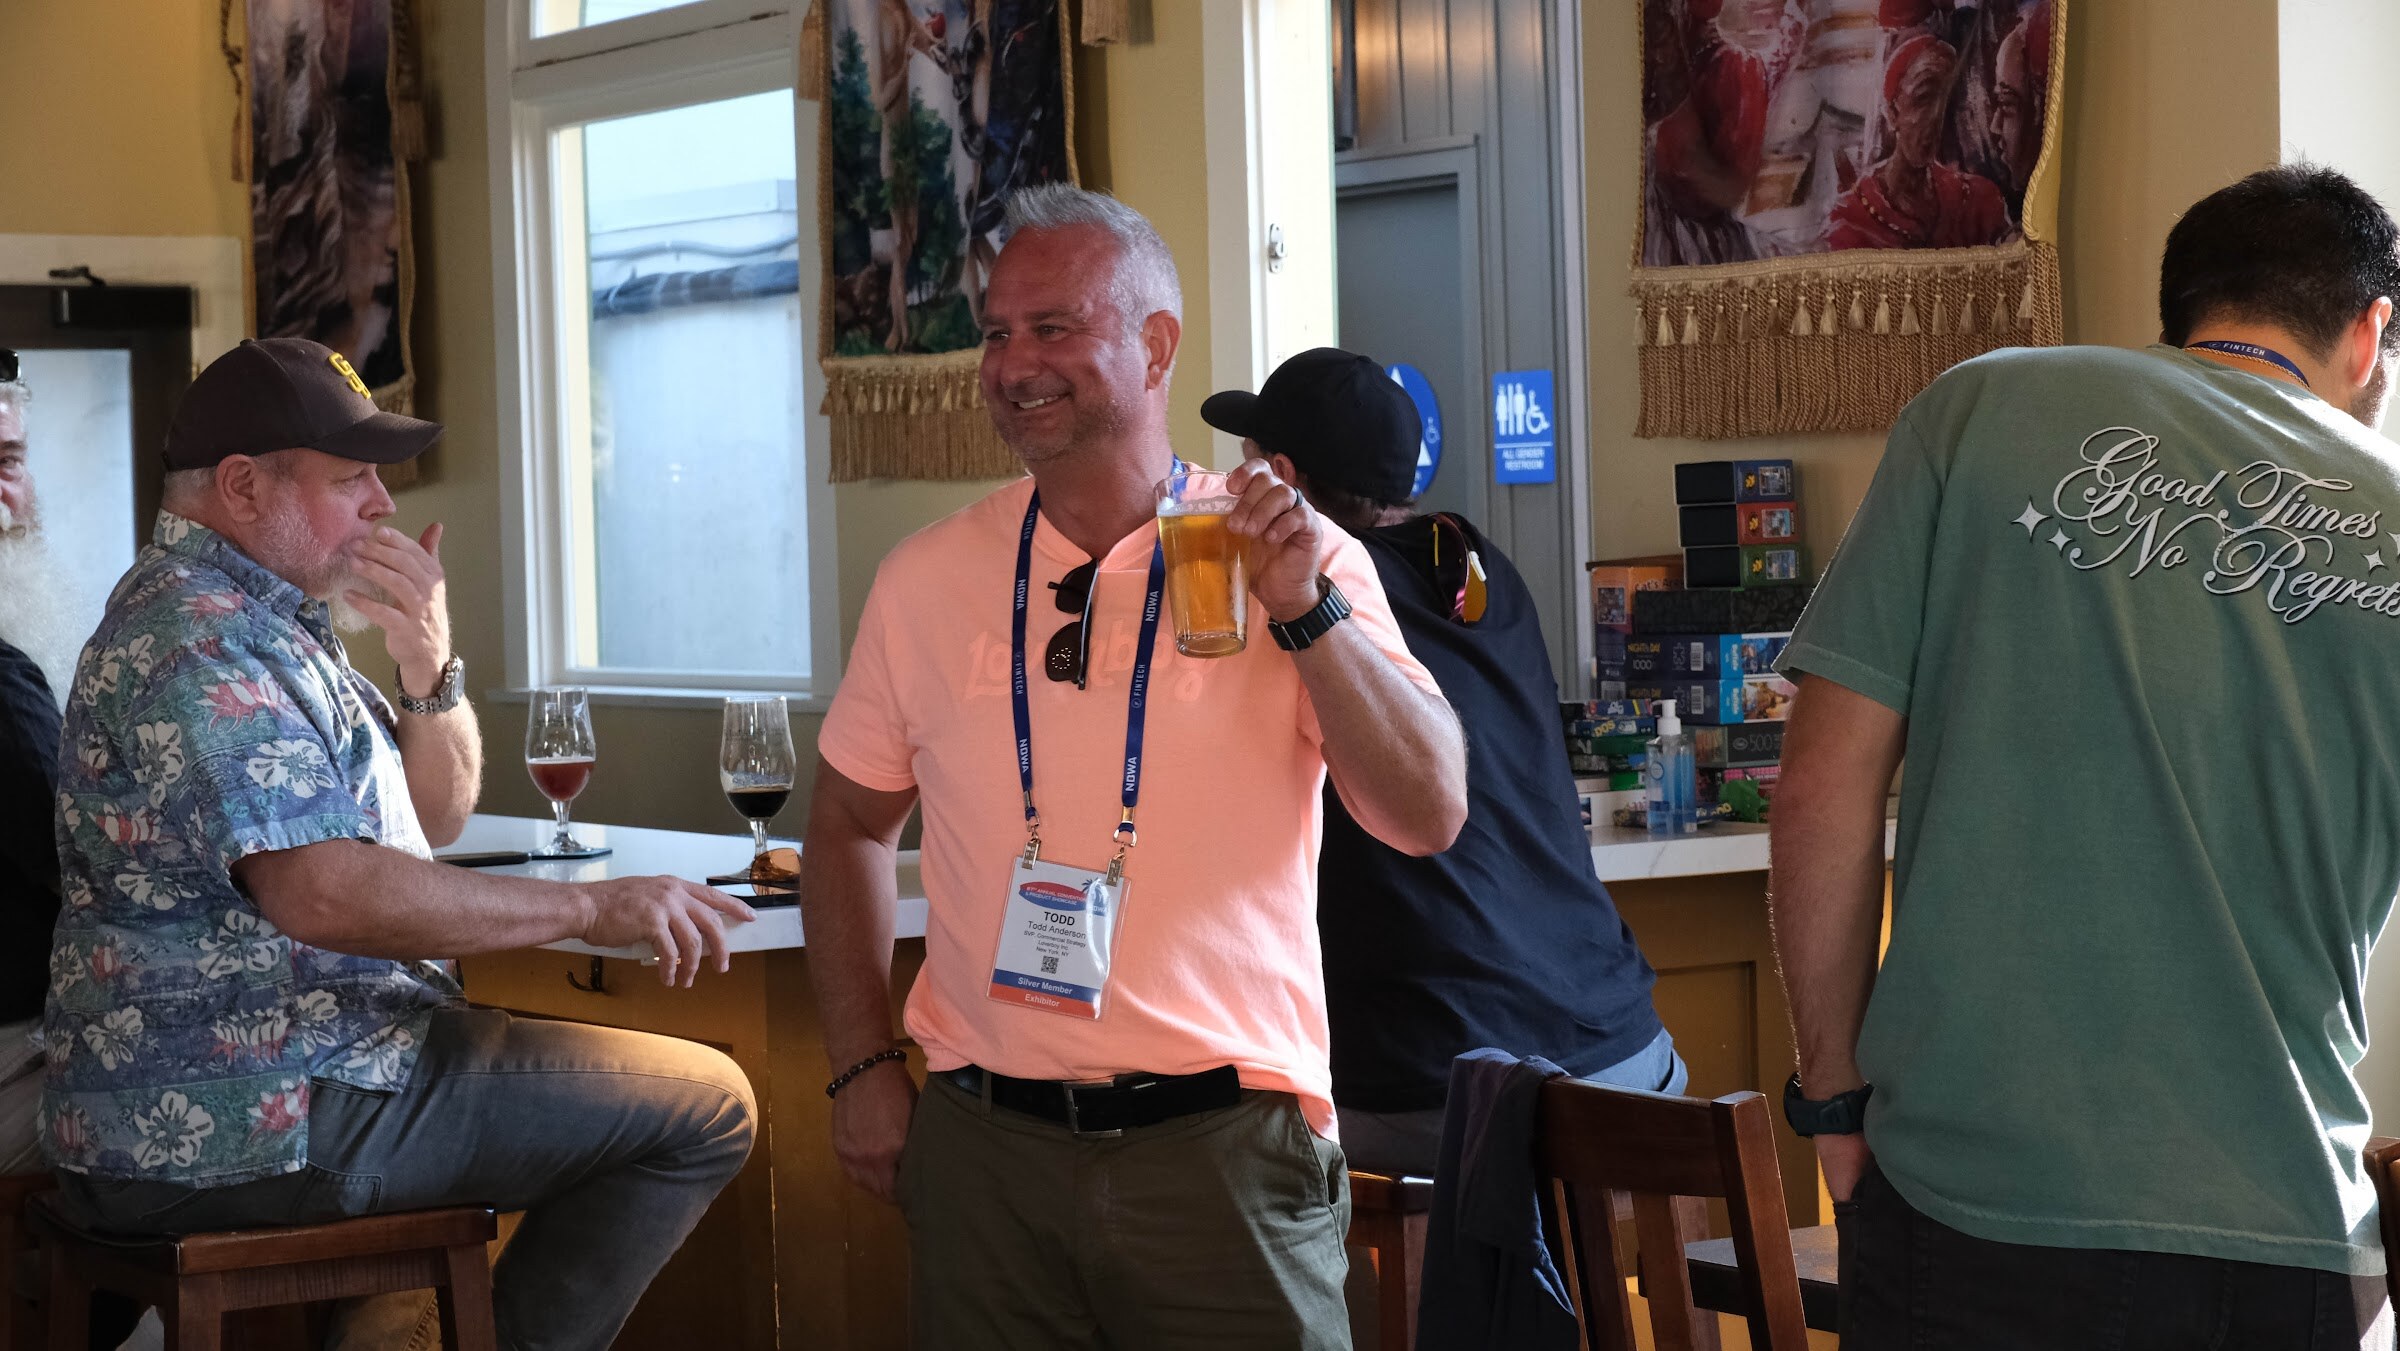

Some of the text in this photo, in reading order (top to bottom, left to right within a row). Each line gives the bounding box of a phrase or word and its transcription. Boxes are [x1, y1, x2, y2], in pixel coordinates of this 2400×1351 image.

[2223, 342, 2266, 356] FINTECH
[2053, 426, 2382, 539] Good Times
[2069, 507, 2400, 623] No Regrets
[1133, 663, 1147, 697] FINTECH
[1029, 892, 1051, 900] PRODUCT
[1044, 911, 1075, 926] TODD
[1028, 921, 1087, 940] Todd Anderson
[1037, 932, 1065, 944] Commercial
[1018, 977, 1073, 995] Silver Member
[1025, 993, 1060, 1007] Exhibitor
